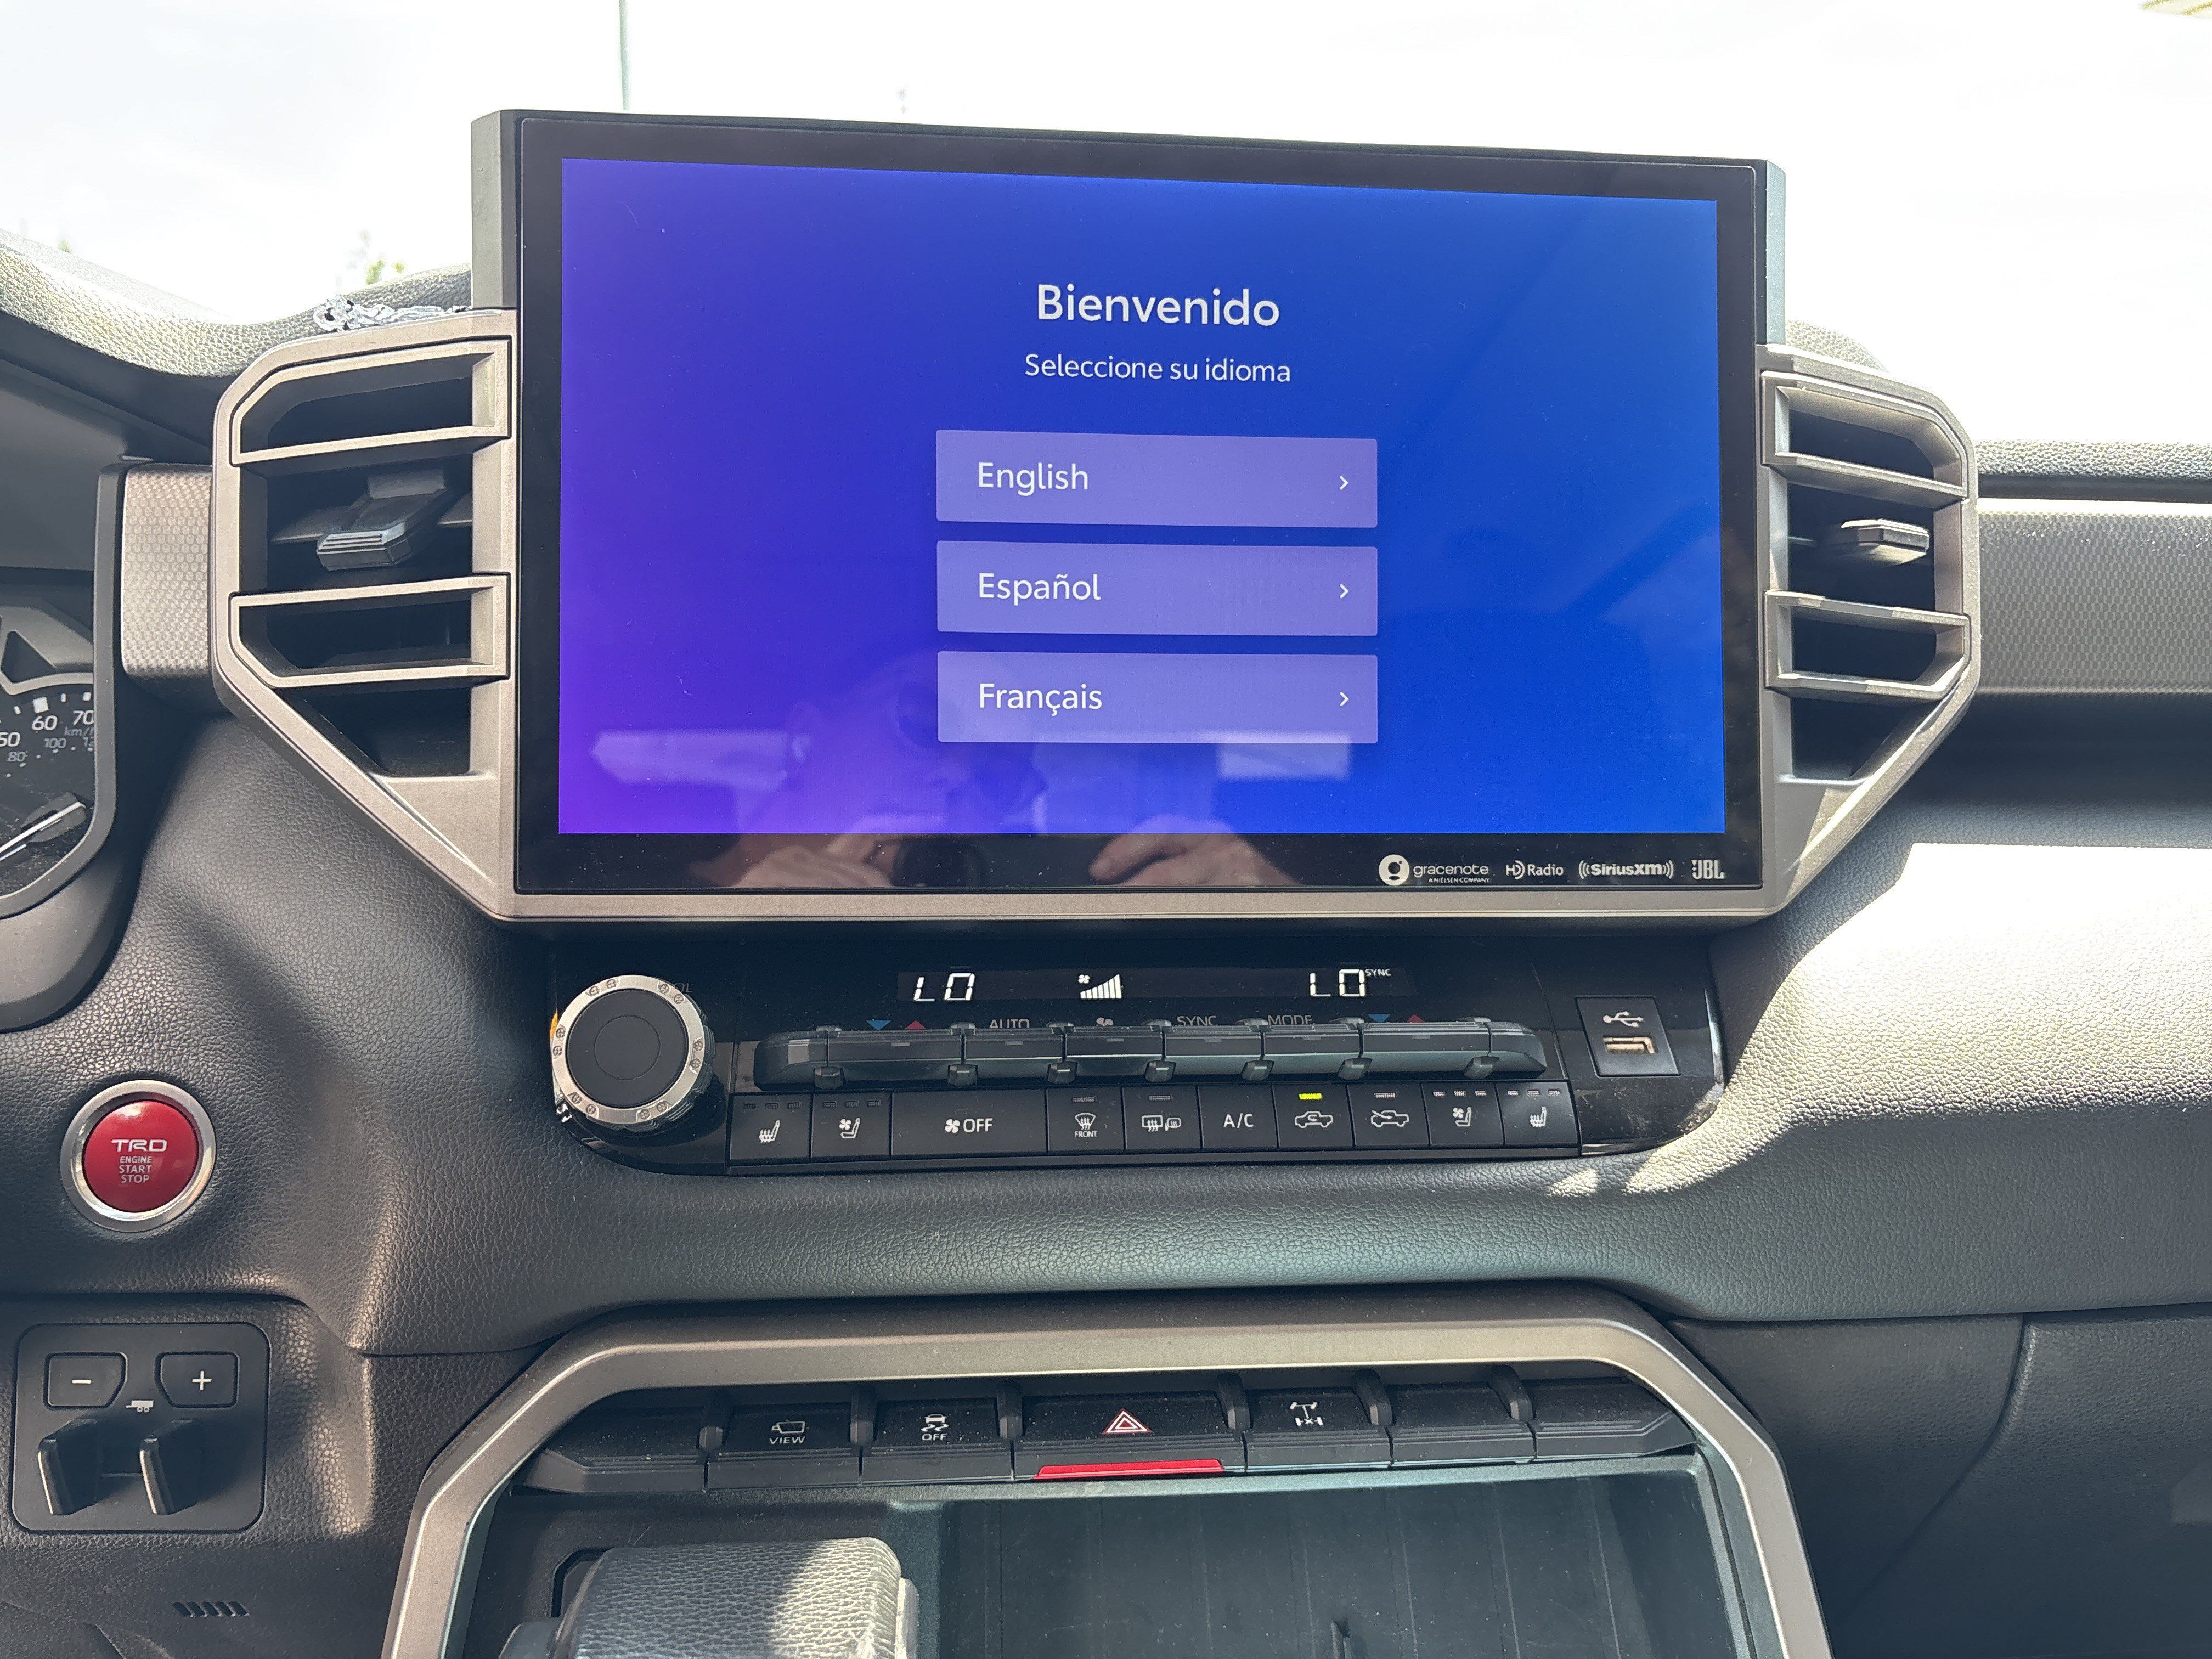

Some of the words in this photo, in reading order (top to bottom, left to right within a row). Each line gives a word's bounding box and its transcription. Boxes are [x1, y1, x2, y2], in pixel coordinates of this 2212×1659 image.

[1037, 283, 1280, 327] Bienvenido
[1025, 353, 1163, 380] Seleccione
[1170, 363, 1198, 380] su
[1205, 358, 1290, 382] idioma
[978, 462, 1089, 496] English
[979, 573, 1101, 606] Español
[980, 683, 1103, 716] Français
[31, 715, 58, 731] 60
[72, 709, 94, 725] 70
[0, 732, 20, 747] 50
[44, 737, 67, 749] 100
[82, 736, 94, 747] 12
[7, 751, 26, 762] 80
[1413, 864, 1489, 878] gracenote
[1505, 860, 1525, 880] HD
[1527, 864, 1564, 876] Radio
[1691, 859, 1725, 879] JBL
[1365, 968, 1392, 977] SYNC
[989, 1019, 1030, 1029] AUTO
[1176, 1015, 1217, 1026] SYNC
[1268, 1014, 1313, 1025] MODE
[963, 1118, 993, 1132] OFF
[1223, 1113, 1254, 1128] A/C
[111, 1139, 168, 1152] TRD
[119, 1165, 153, 1173] START
[121, 1174, 150, 1183] STOP
[769, 1436, 805, 1444] VIEW
